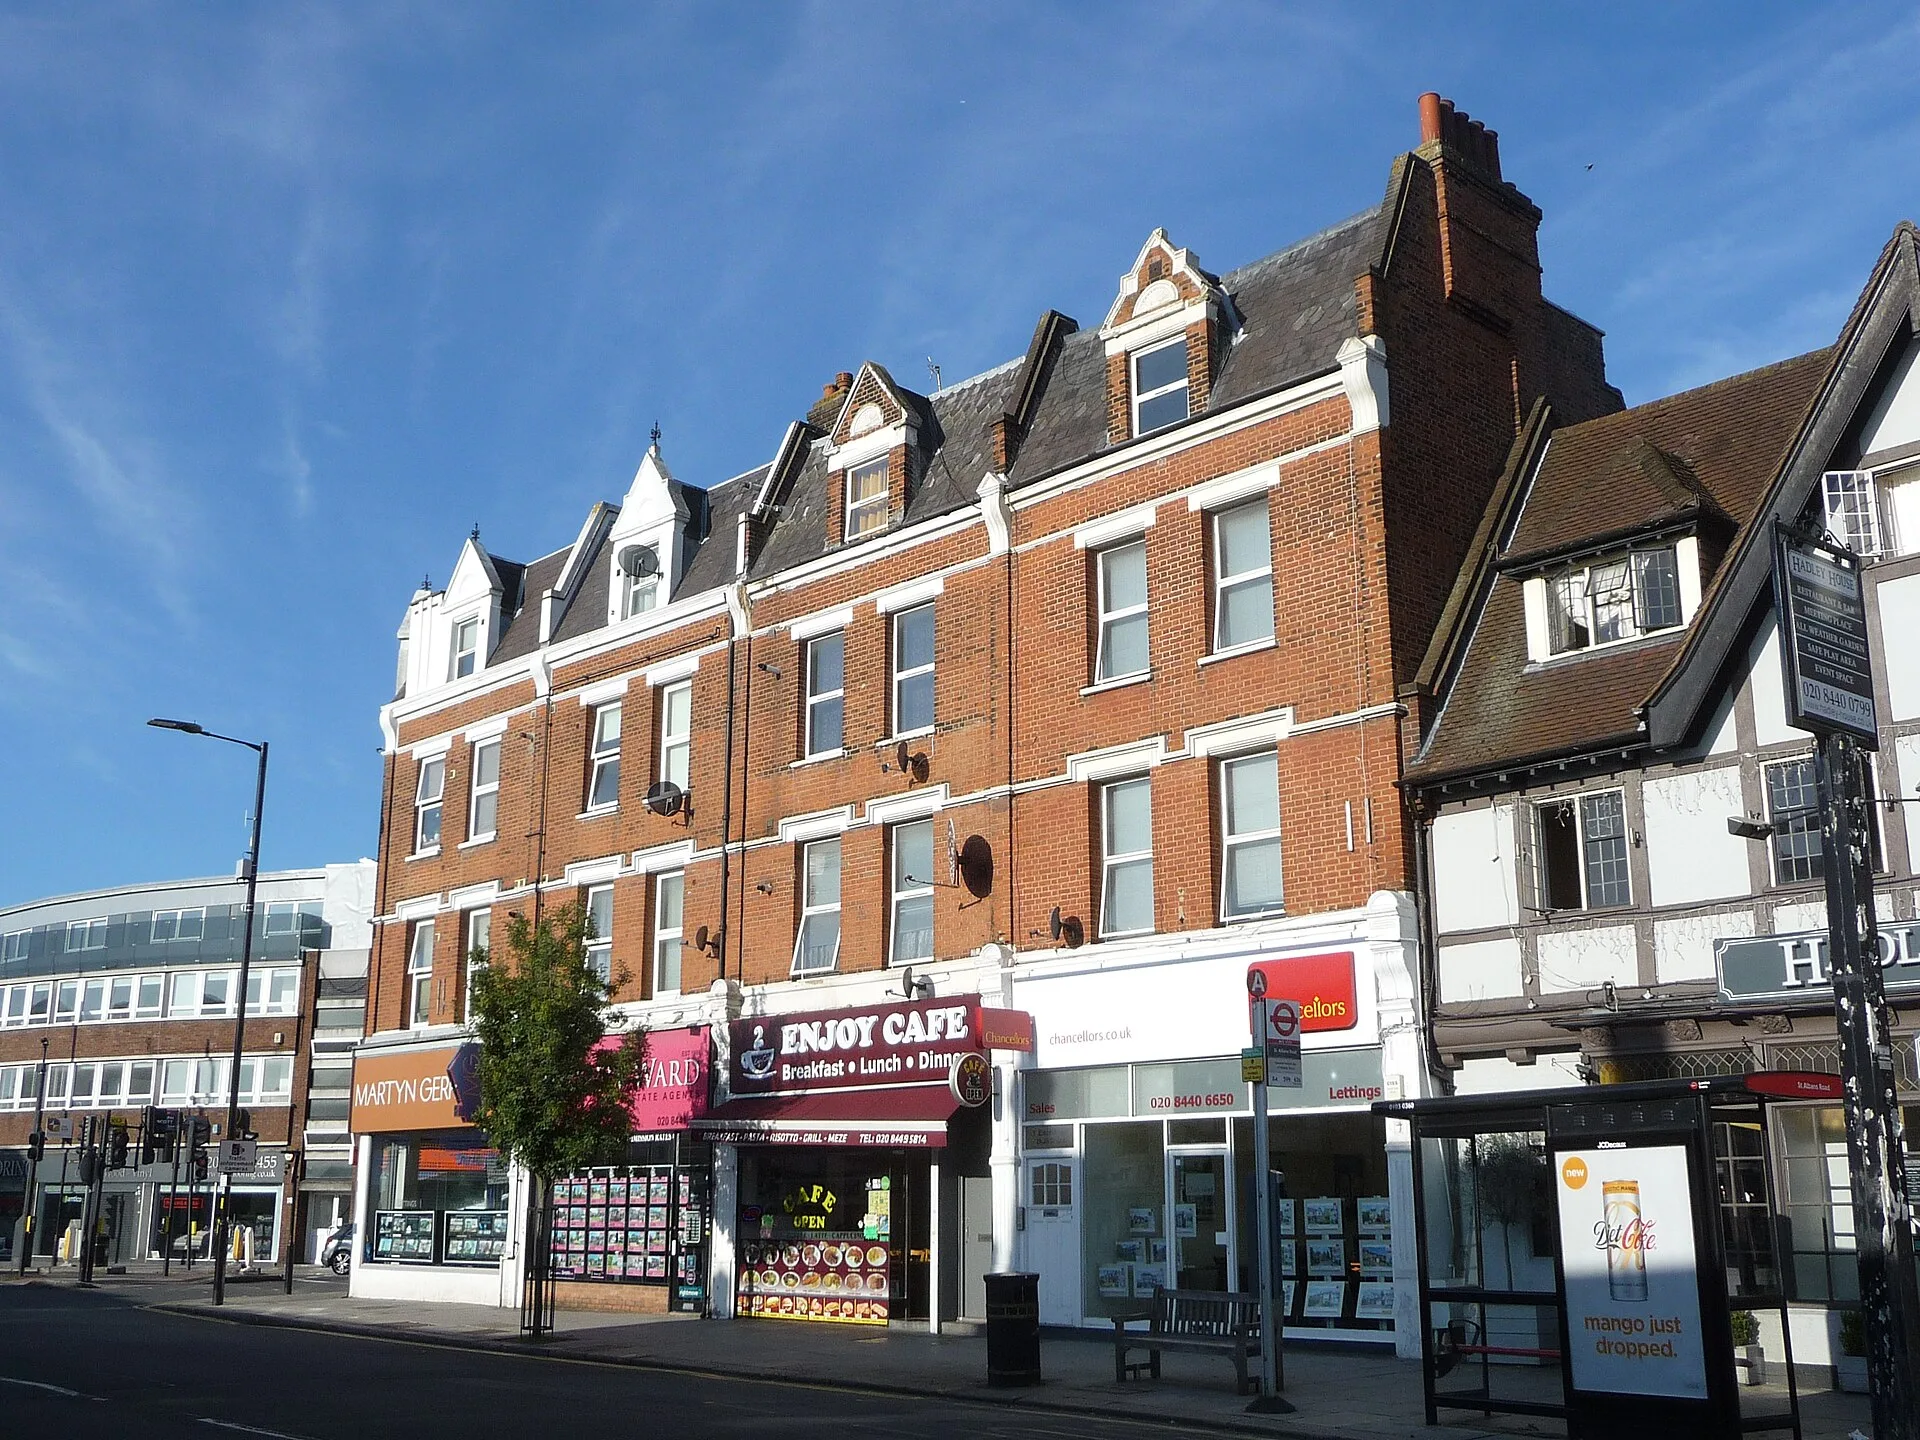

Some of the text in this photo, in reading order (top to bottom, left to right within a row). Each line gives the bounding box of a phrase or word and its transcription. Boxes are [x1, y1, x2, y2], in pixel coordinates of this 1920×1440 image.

[1792, 555, 1855, 591] HADLEY HOUSE
[1796, 584, 1836, 608] RESTAURANT
[1843, 603, 1856, 615] BAR
[1803, 605, 1853, 632] MEETING PLACE
[1809, 626, 1839, 644] WEATHER
[1839, 637, 1866, 654] GARDEN
[1807, 642, 1857, 668] SAFE PLAY AREA
[1814, 663, 1855, 685] EVENT SPACE
[1803, 681, 1871, 718] 020 8440 0799
[1251, 971, 1266, 993] A
[780, 1005, 969, 1055] ENJOY CAFE
[985, 1031, 1030, 1046] Chancellors
[1049, 1026, 1132, 1046] chancellors.co.uk
[782, 1059, 844, 1081] Breakfast
[860, 1054, 902, 1075] Lunch
[963, 1059, 986, 1075] CAFE
[354, 1079, 417, 1107] MARTYN
[1329, 1085, 1382, 1101] Lettings
[1804, 1082, 1819, 1091] Albans
[1819, 1084, 1831, 1092] Road
[1029, 1102, 1056, 1114] Sales
[1150, 1092, 1234, 1109] 020 8440 6650
[702, 1131, 740, 1142] BREAKFAST
[769, 1133, 799, 1143] RISOTTO
[802, 1133, 822, 1143] GRILL
[827, 1133, 848, 1143] MEZE
[859, 1133, 875, 1144] TEL:
[875, 1133, 890, 1144] 020
[1597, 1141, 1627, 1149] JCDecaux
[1566, 1168, 1585, 1178] new
[783, 1184, 837, 1214] CAFE
[794, 1215, 826, 1229] OPEN
[1593, 1217, 1657, 1252] Diet Coke
[1584, 1314, 1682, 1336] mango just
[1595, 1336, 1678, 1361] dropped.
